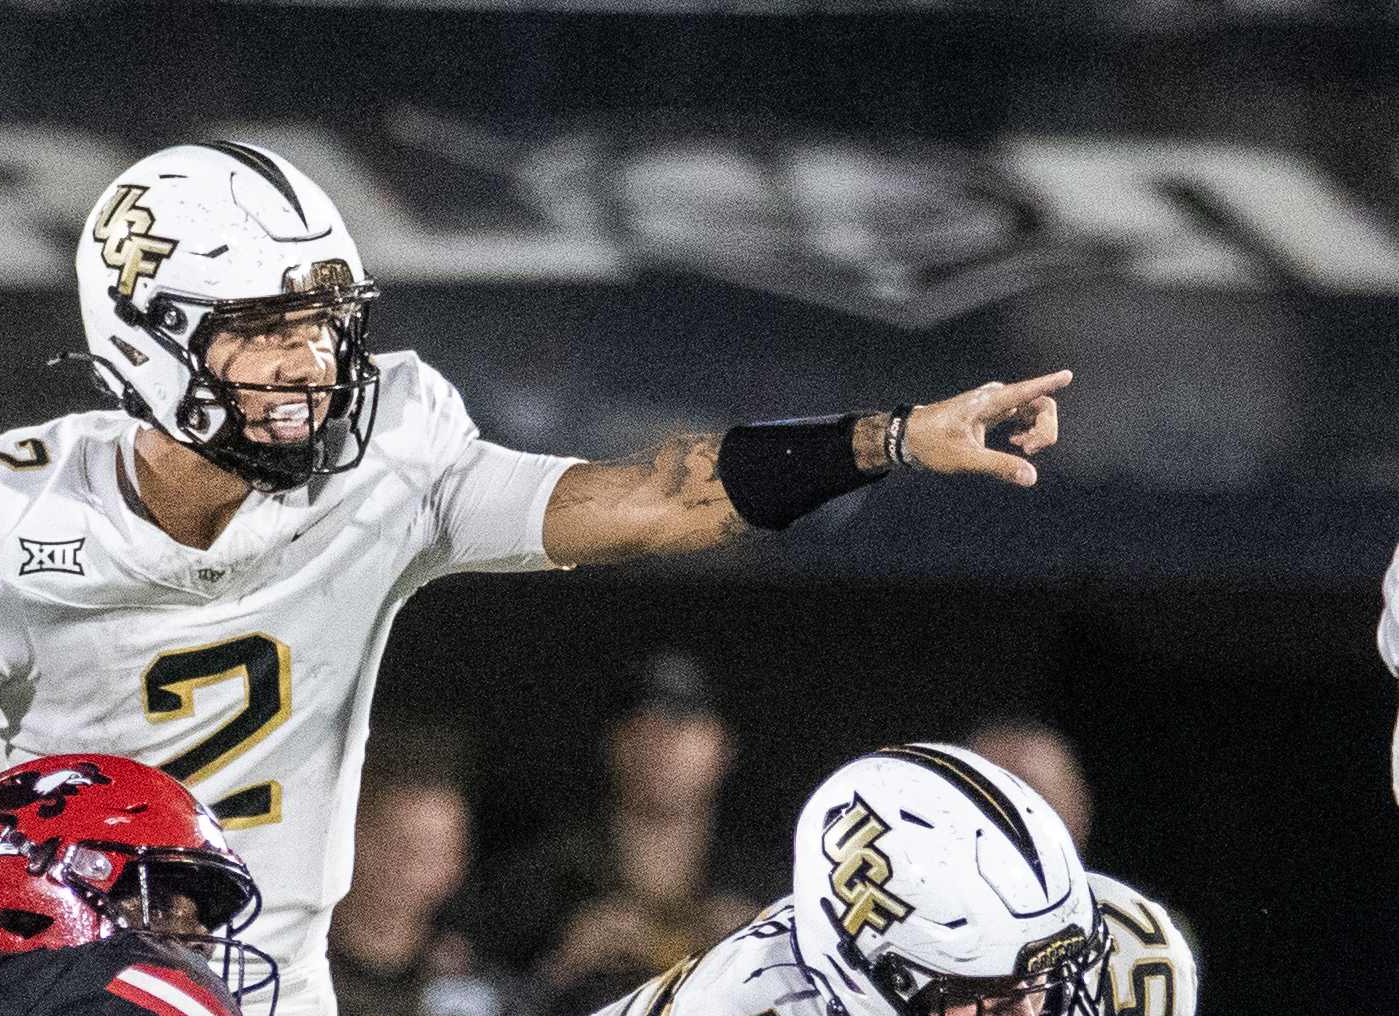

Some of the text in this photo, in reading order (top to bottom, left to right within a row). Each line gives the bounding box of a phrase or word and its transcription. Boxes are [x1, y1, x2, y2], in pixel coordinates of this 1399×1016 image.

[92, 184, 180, 297] UCF
[18, 537, 86, 577] XII
[140, 631, 293, 831] 2
[821, 790, 917, 940] UCF
